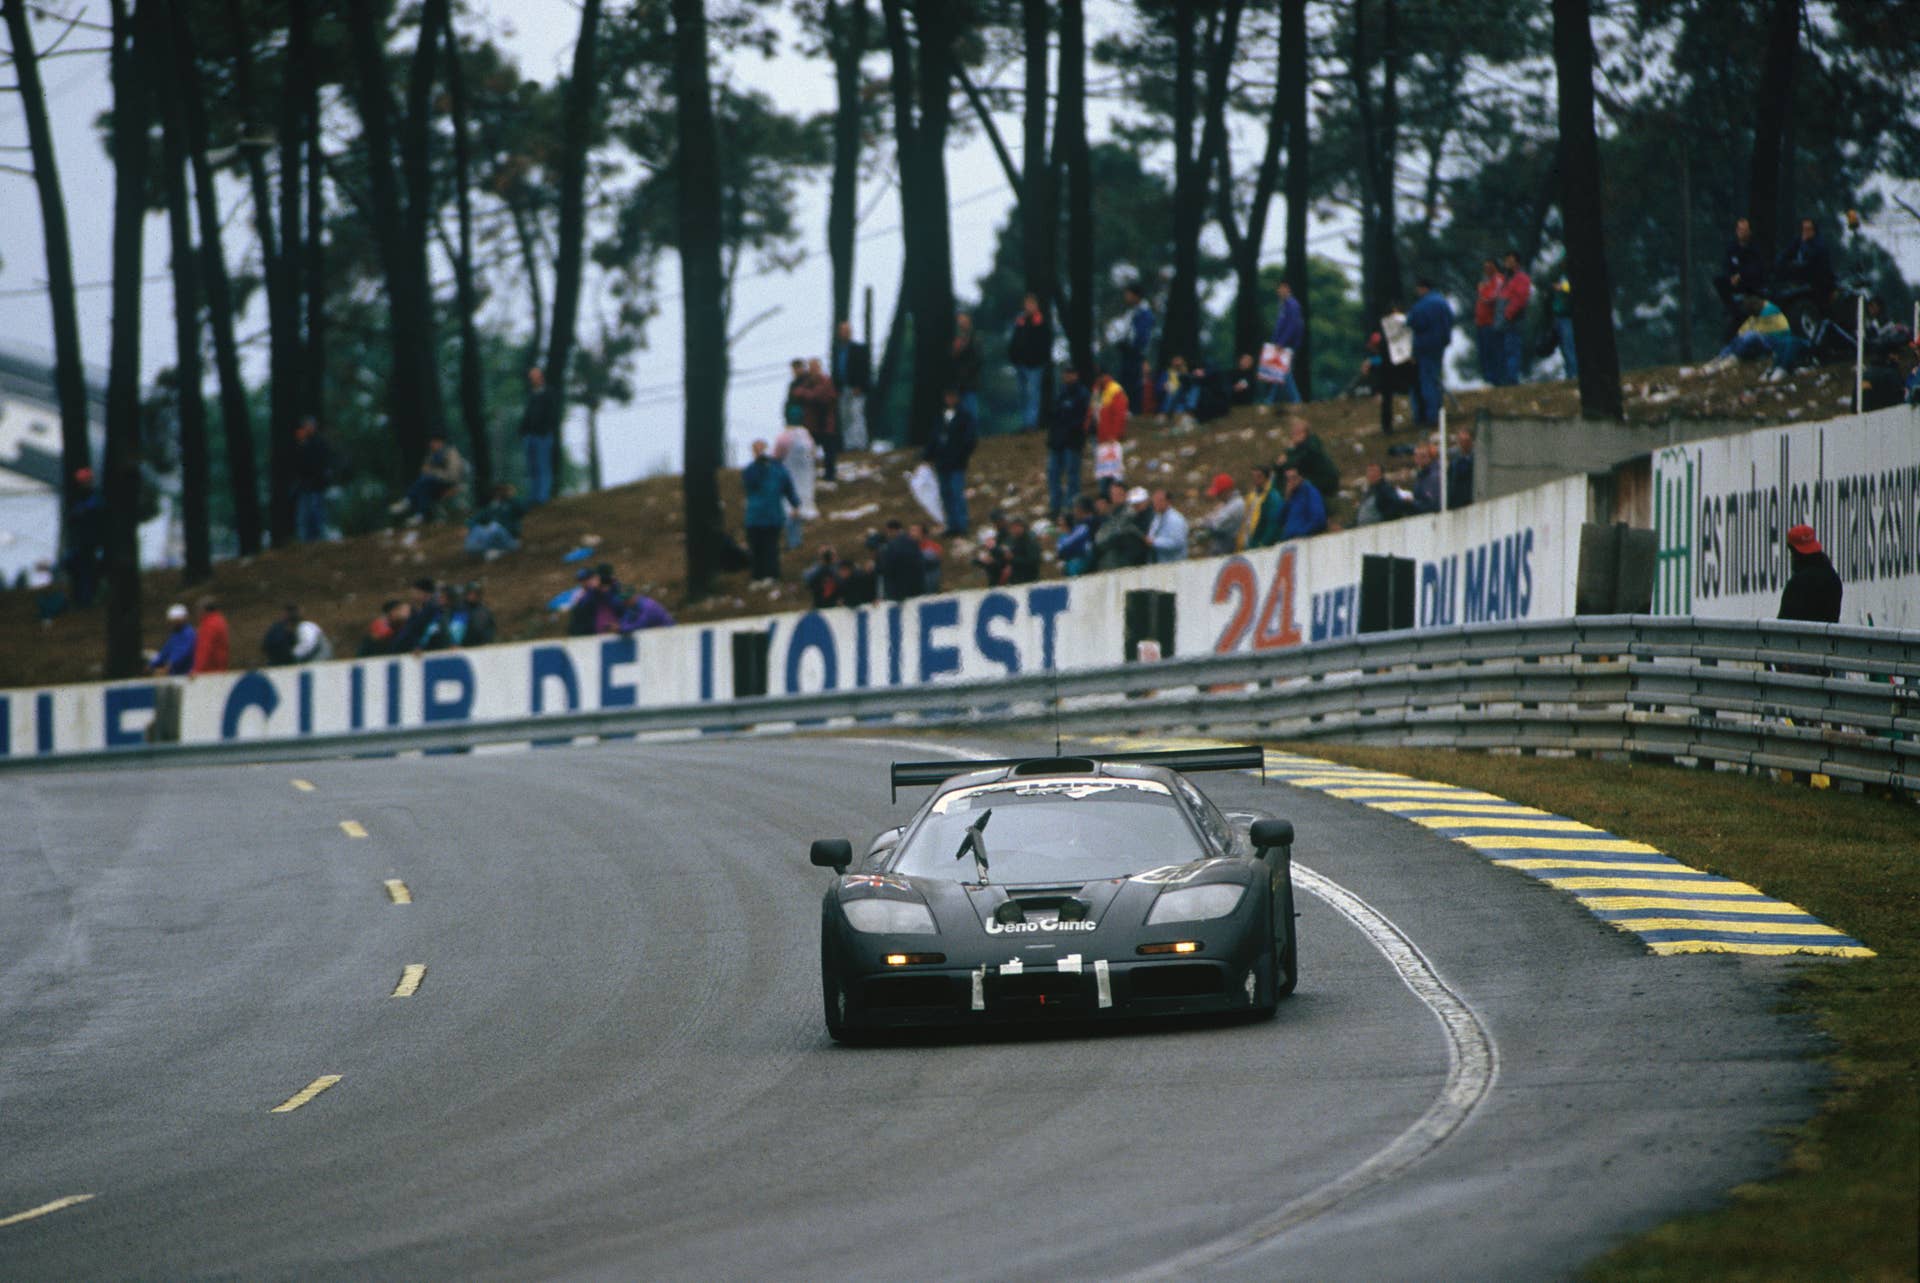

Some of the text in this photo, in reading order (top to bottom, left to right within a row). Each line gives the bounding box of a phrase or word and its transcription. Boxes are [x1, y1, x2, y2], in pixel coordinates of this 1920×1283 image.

[1464, 527, 1534, 624] MANS
[1695, 447, 1722, 600] les
[1212, 546, 1301, 654] 24
